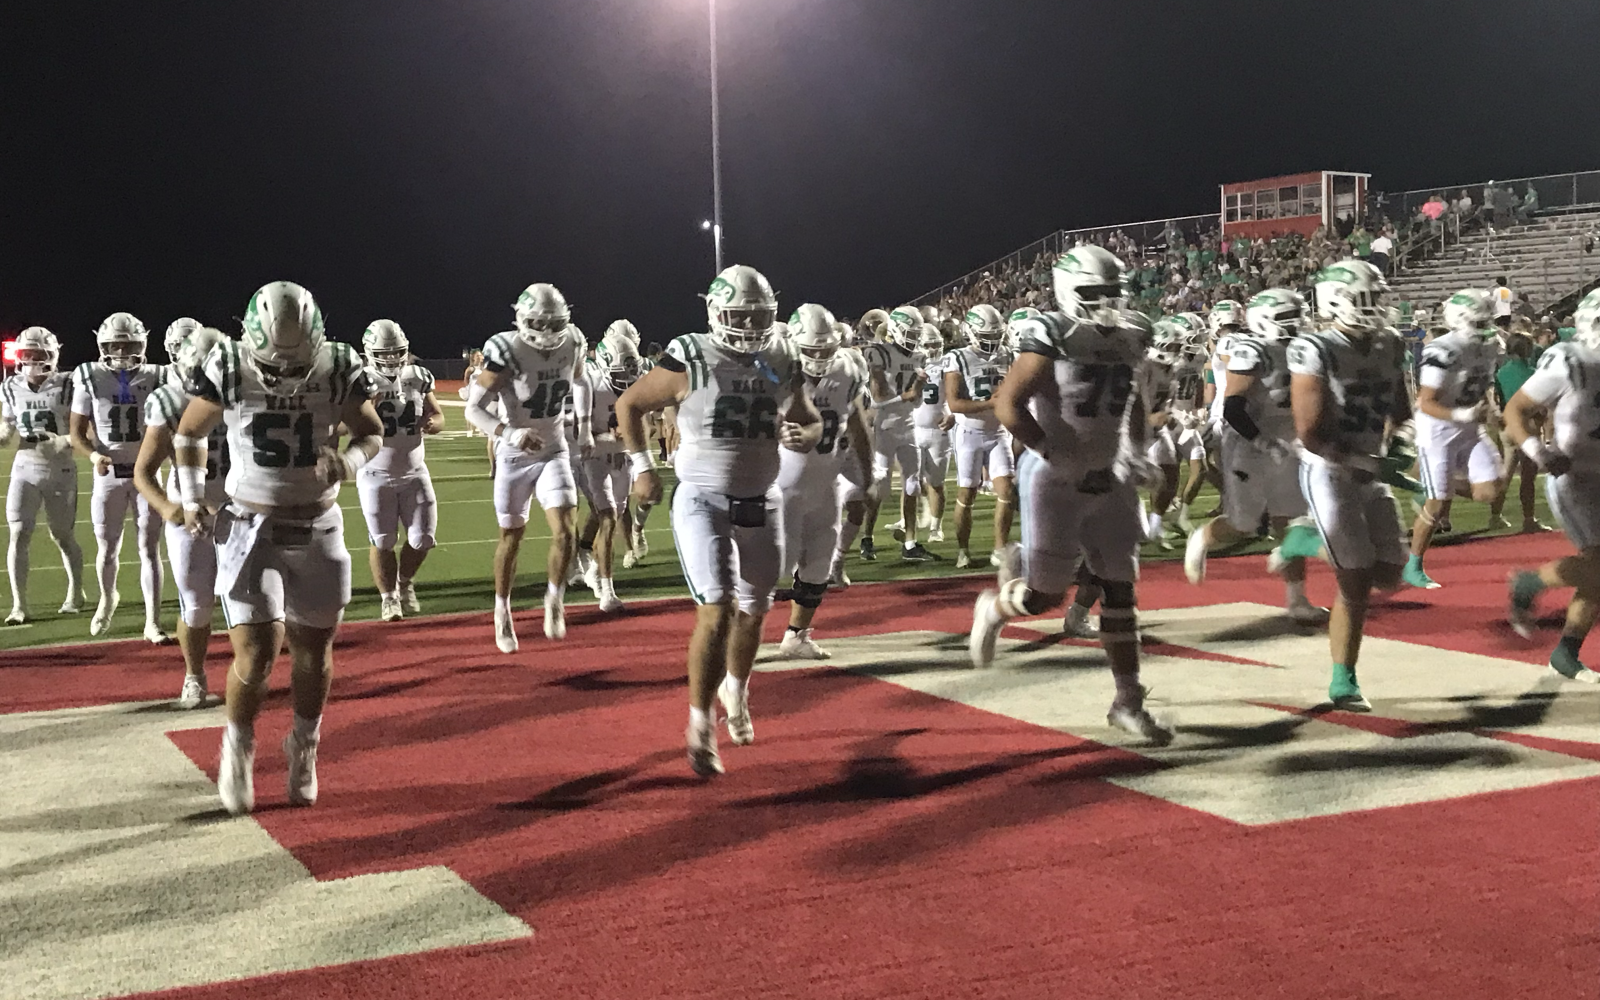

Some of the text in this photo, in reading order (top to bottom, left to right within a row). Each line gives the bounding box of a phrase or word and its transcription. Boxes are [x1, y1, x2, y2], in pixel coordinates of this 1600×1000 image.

[537, 369, 561, 381] WALL
[732, 380, 766, 393] WALL
[922, 384, 939, 404] 3
[26, 400, 47, 410] WALL
[265, 394, 307, 410] WALL
[108, 406, 141, 442] 11
[377, 401, 416, 437] 64
[711, 396, 777, 438] 66
[253, 413, 317, 467] 51
